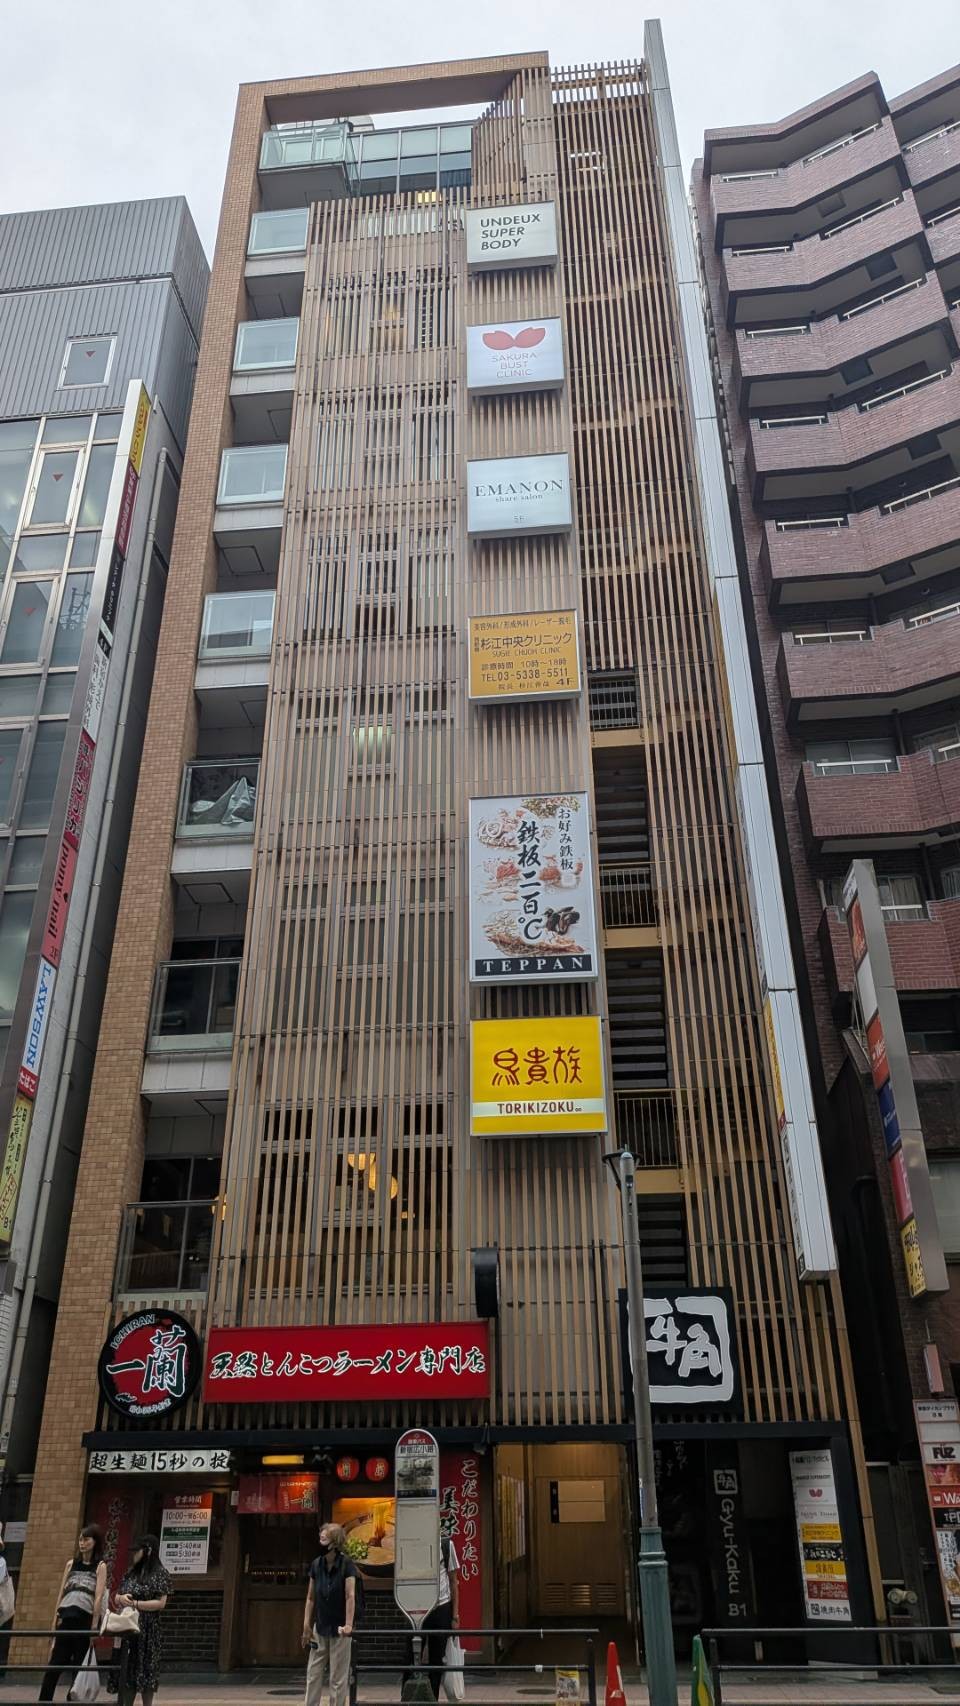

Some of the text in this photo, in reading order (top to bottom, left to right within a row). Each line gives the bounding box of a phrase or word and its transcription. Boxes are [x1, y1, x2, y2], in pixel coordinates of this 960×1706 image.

[480, 213, 541, 228] UNDEUX
[481, 226, 525, 239] SUPER
[481, 238, 522, 251] BODY
[491, 352, 538, 363] SAKURA
[500, 360, 528, 370] BUST
[496, 368, 534, 379] CLINIC
[474, 480, 563, 497] EMANON
[495, 493, 543, 503] share salon
[480, 632, 572, 650] 杉江中央クリニック
[540, 646, 561, 655] CLINIC
[558, 808, 574, 871] お好み鉄板
[48, 899, 61, 939] nail
[482, 956, 584, 973] TEPPAN
[26, 963, 52, 1069] LAWSON
[491, 1046, 583, 1086] 鳥貴族
[110, 1314, 156, 1350] ICHIRAN
[106, 1324, 188, 1397] 一蘭
[208, 1345, 487, 1379] 天然とんこつラーメン専門店
[461, 1460, 479, 1582] こだわりたい
[728, 1603, 747, 1616] B1
